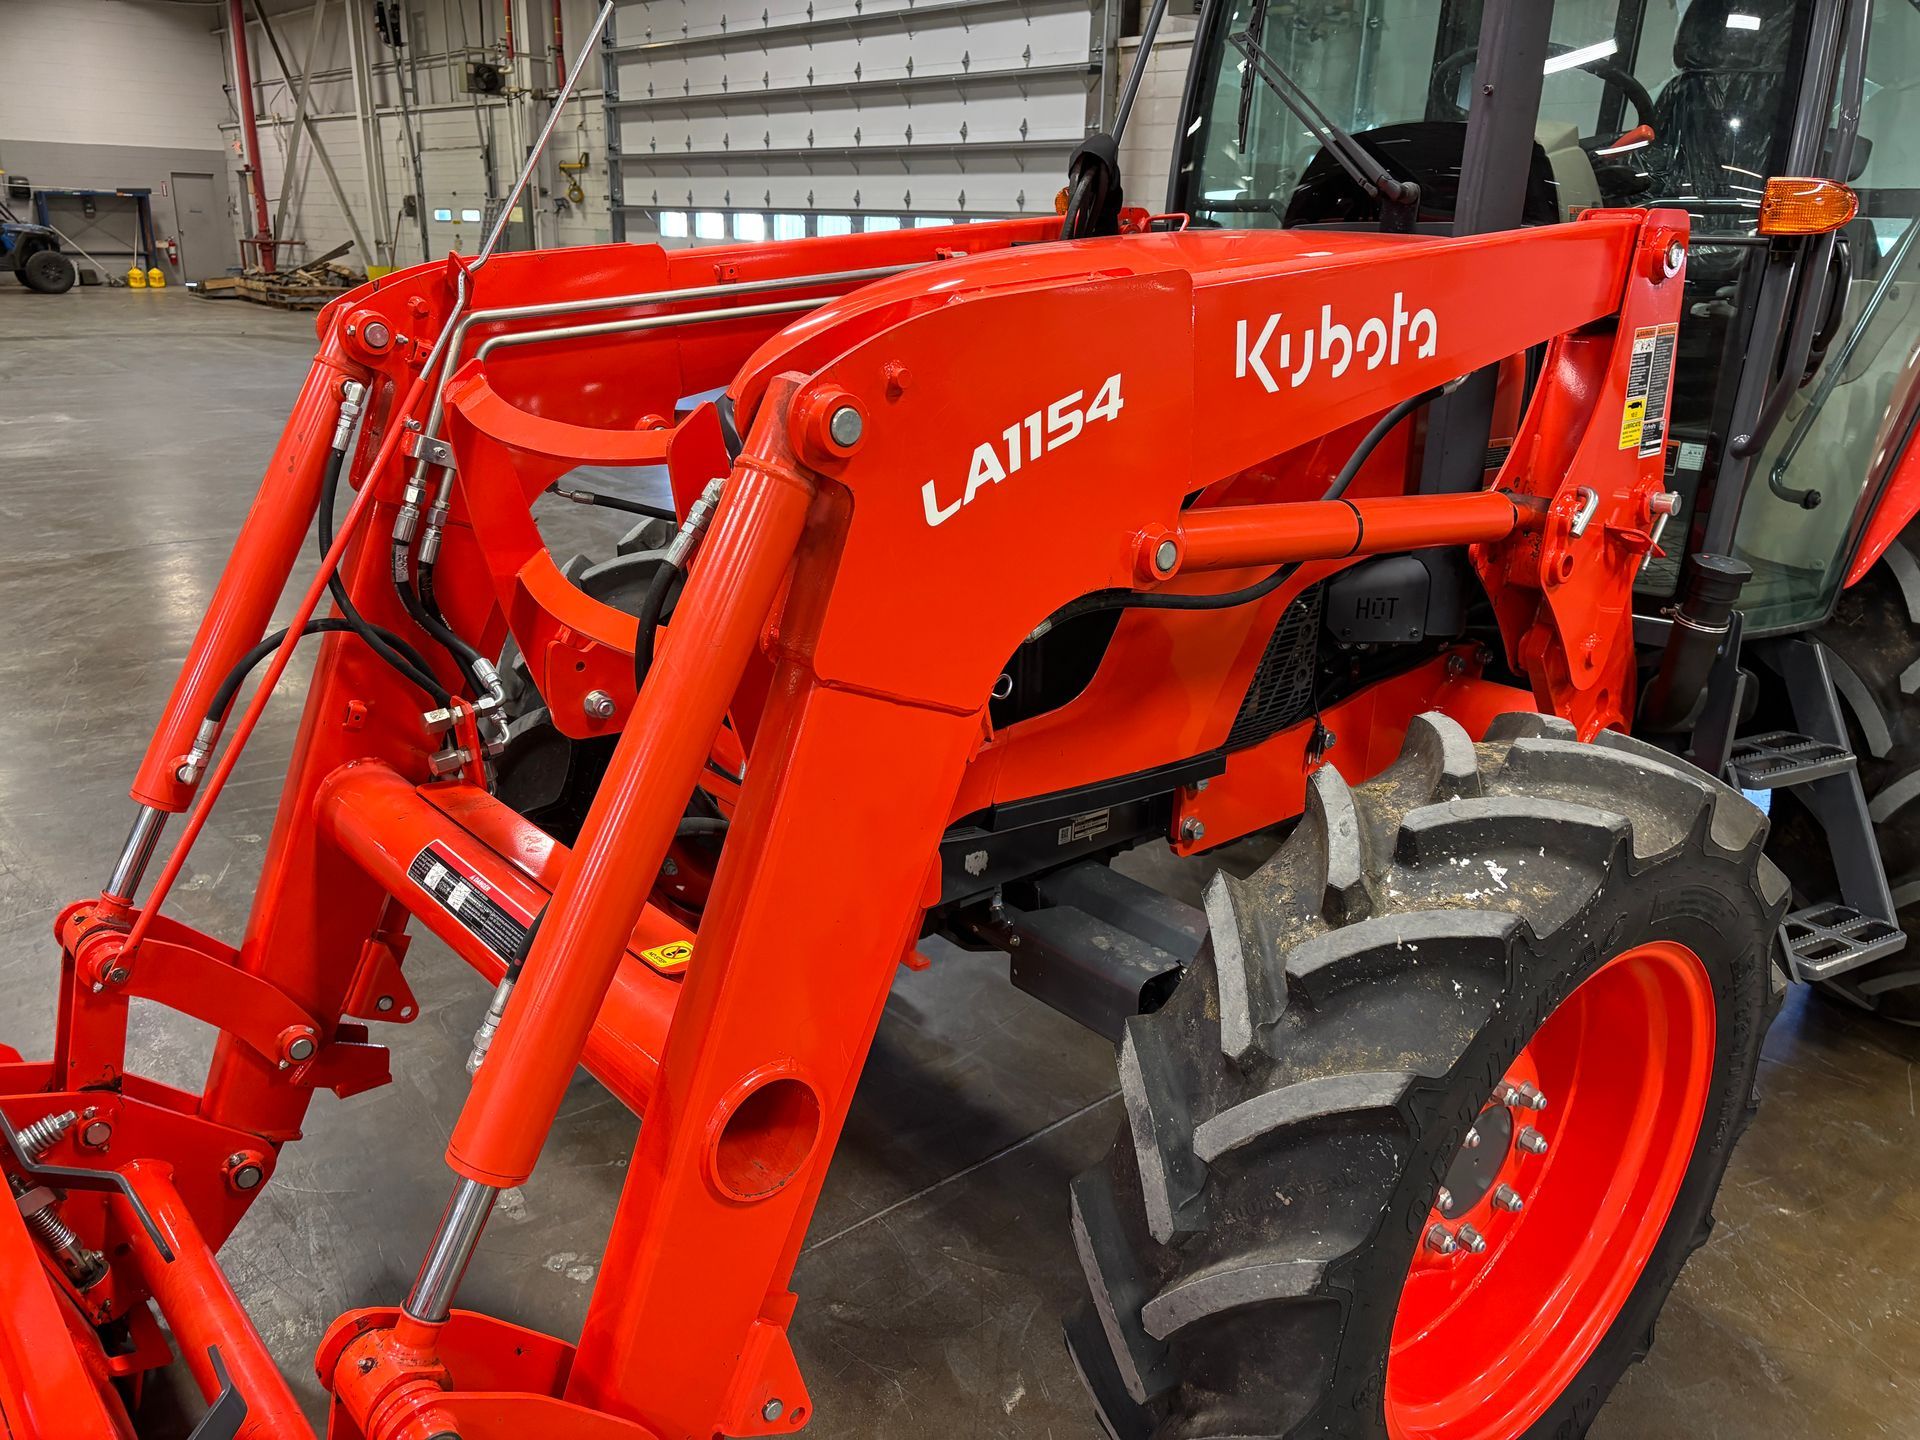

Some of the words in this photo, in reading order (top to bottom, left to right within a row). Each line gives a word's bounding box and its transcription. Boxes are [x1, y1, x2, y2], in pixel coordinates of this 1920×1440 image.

[1235, 292, 1437, 393] Kubota
[921, 373, 1124, 527] LA1154
[1356, 597, 1399, 619] HOT
